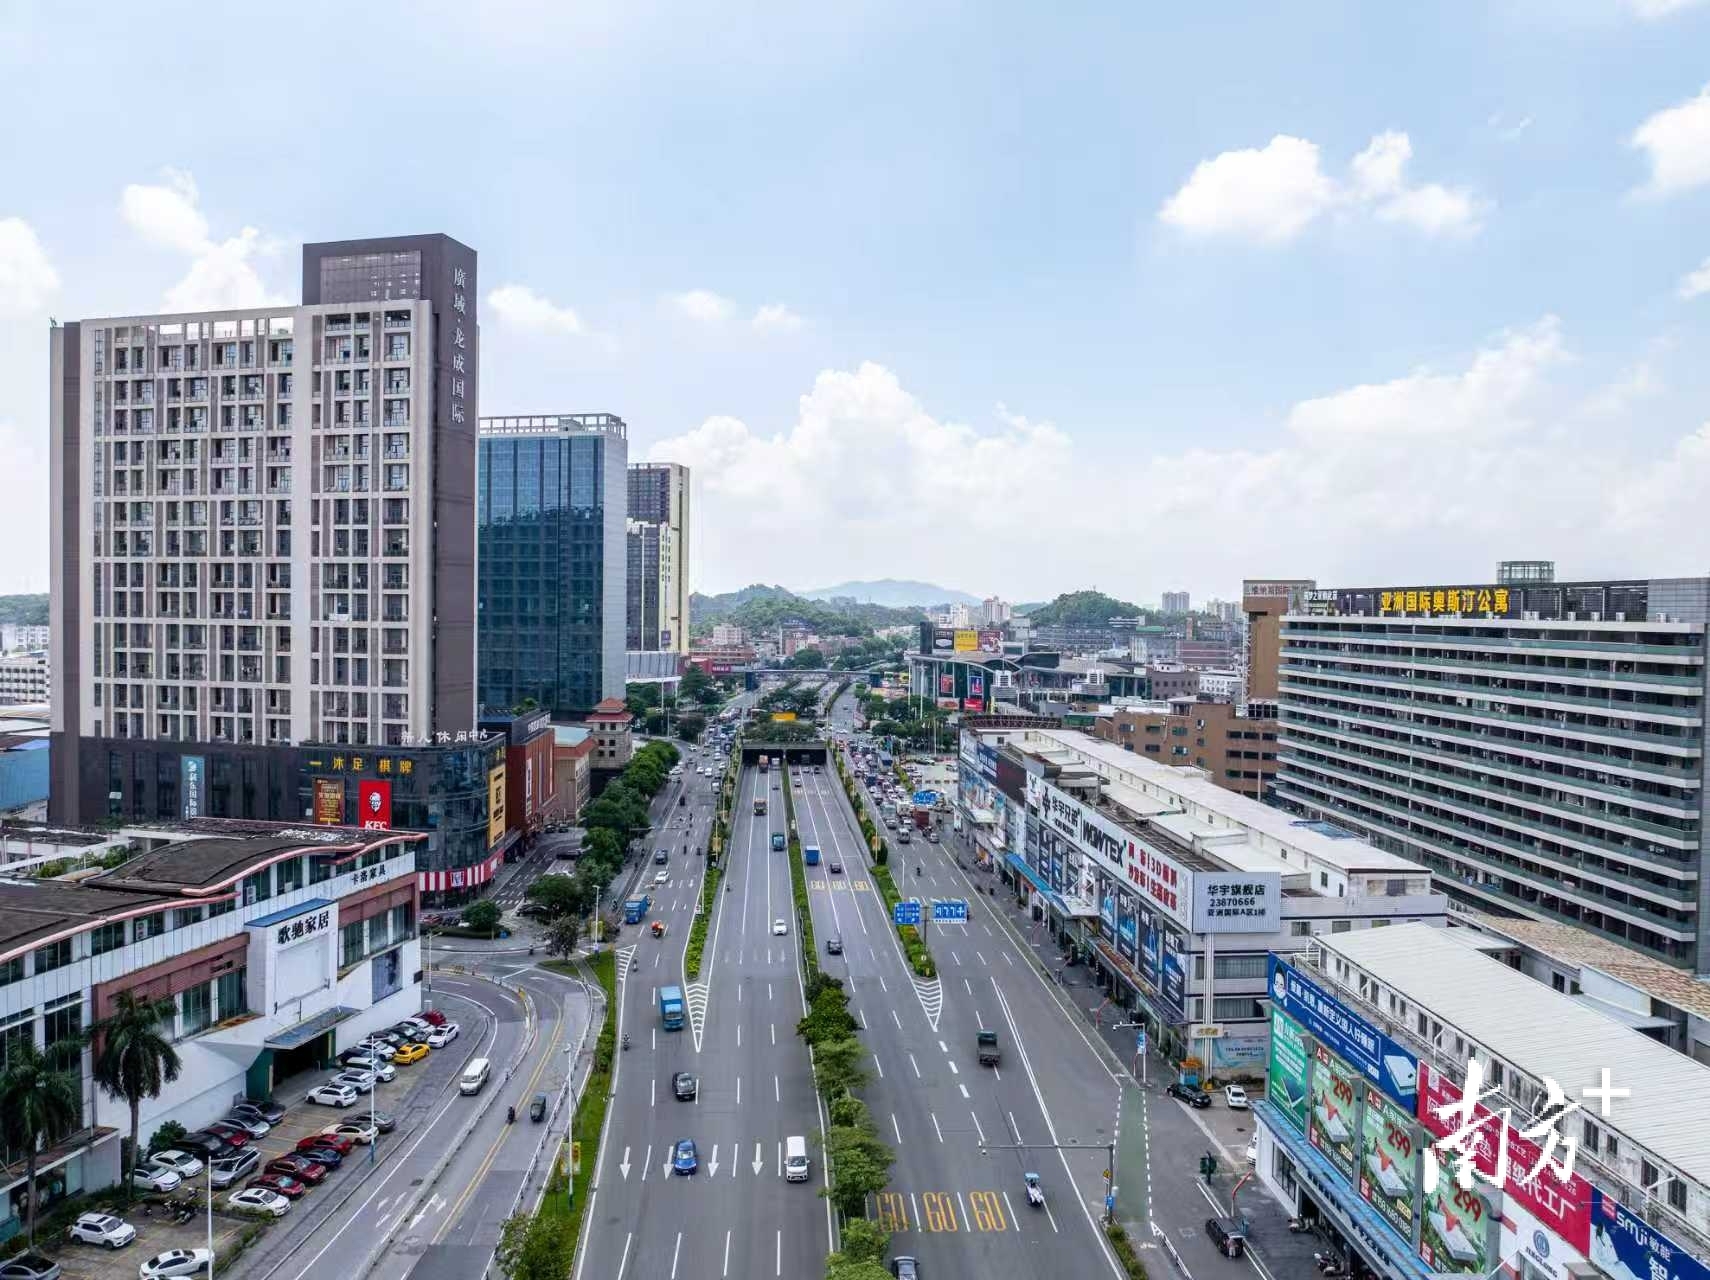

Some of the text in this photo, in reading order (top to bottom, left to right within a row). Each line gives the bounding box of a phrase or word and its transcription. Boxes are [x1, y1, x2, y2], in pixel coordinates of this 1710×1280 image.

[1381, 588, 1509, 613] 亚洲国际奥斯汀公寓
[1207, 884, 1265, 896] 华宇旗舰店
[1209, 897, 1256, 907] 23870666
[922, 1192, 958, 1232] 60
[969, 1192, 1006, 1231] 60
